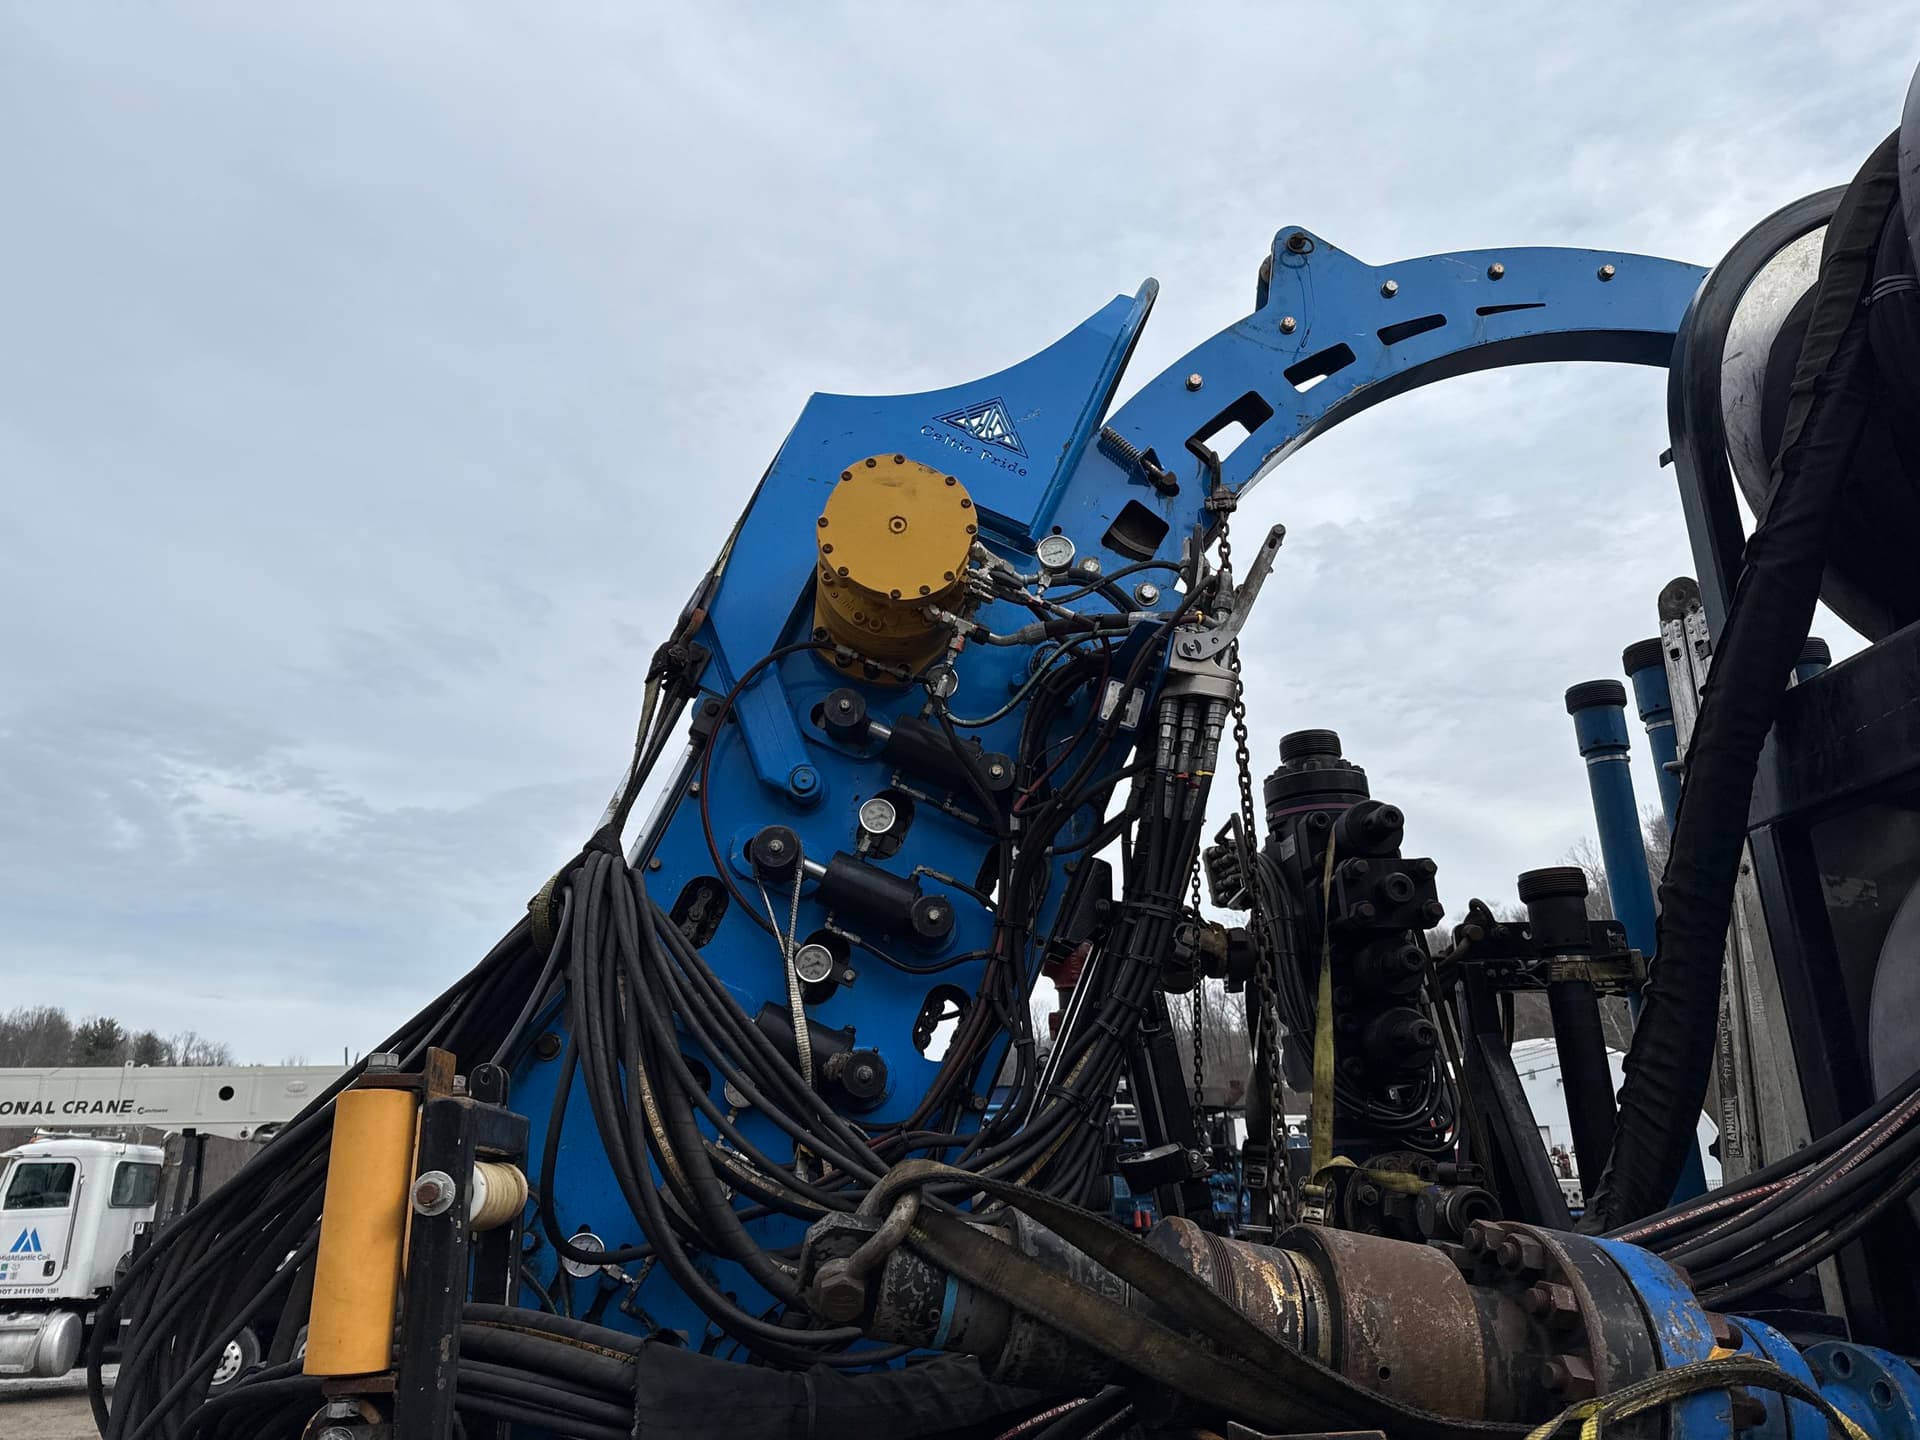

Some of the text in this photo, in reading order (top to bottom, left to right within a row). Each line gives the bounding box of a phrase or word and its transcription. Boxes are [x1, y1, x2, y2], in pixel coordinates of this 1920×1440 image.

[920, 424, 1028, 477] Celtic Pride
[62, 1099, 135, 1114] CRANE
[1724, 1099, 1740, 1156] FRANKLIN
[1057, 1400, 1077, 1413] BAR
[1016, 1419, 1033, 1432] PSI
